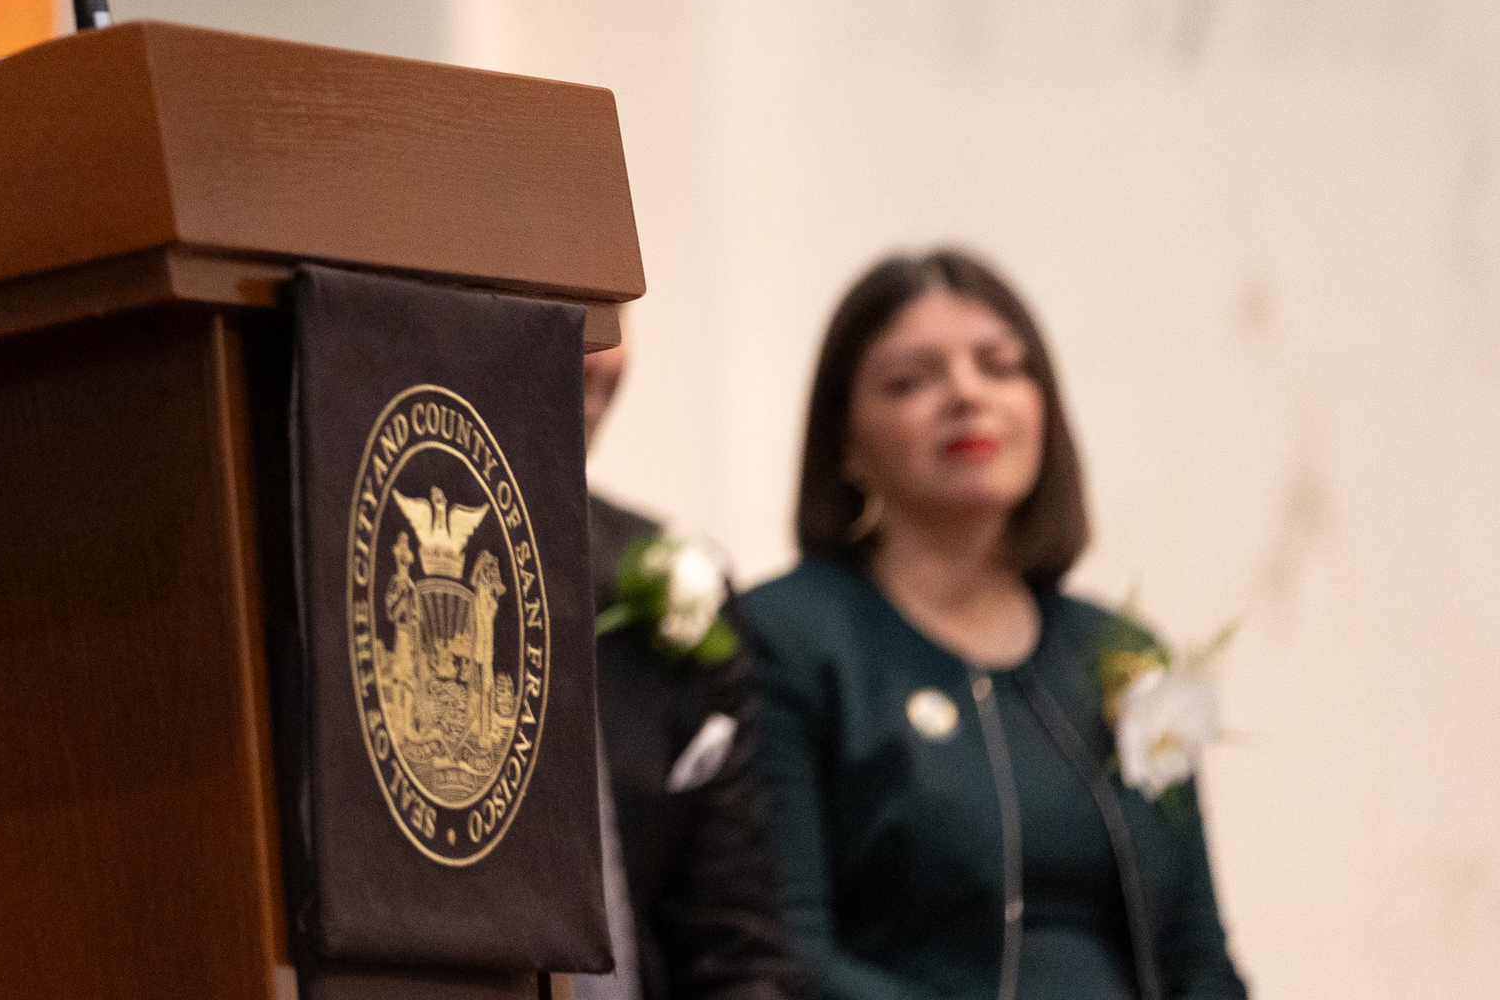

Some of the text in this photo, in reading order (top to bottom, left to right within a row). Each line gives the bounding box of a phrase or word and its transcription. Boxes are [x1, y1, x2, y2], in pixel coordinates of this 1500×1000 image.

[372, 412, 410, 488] AND
[411, 402, 499, 482] COUNTY
[354, 476, 379, 587] CITY
[496, 480, 523, 529] OF
[515, 540, 543, 631] SAN
[355, 601, 375, 698] THE
[366, 708, 390, 761] OF
[467, 642, 544, 844] FRANCISCO
[389, 758, 438, 840] SEAL
